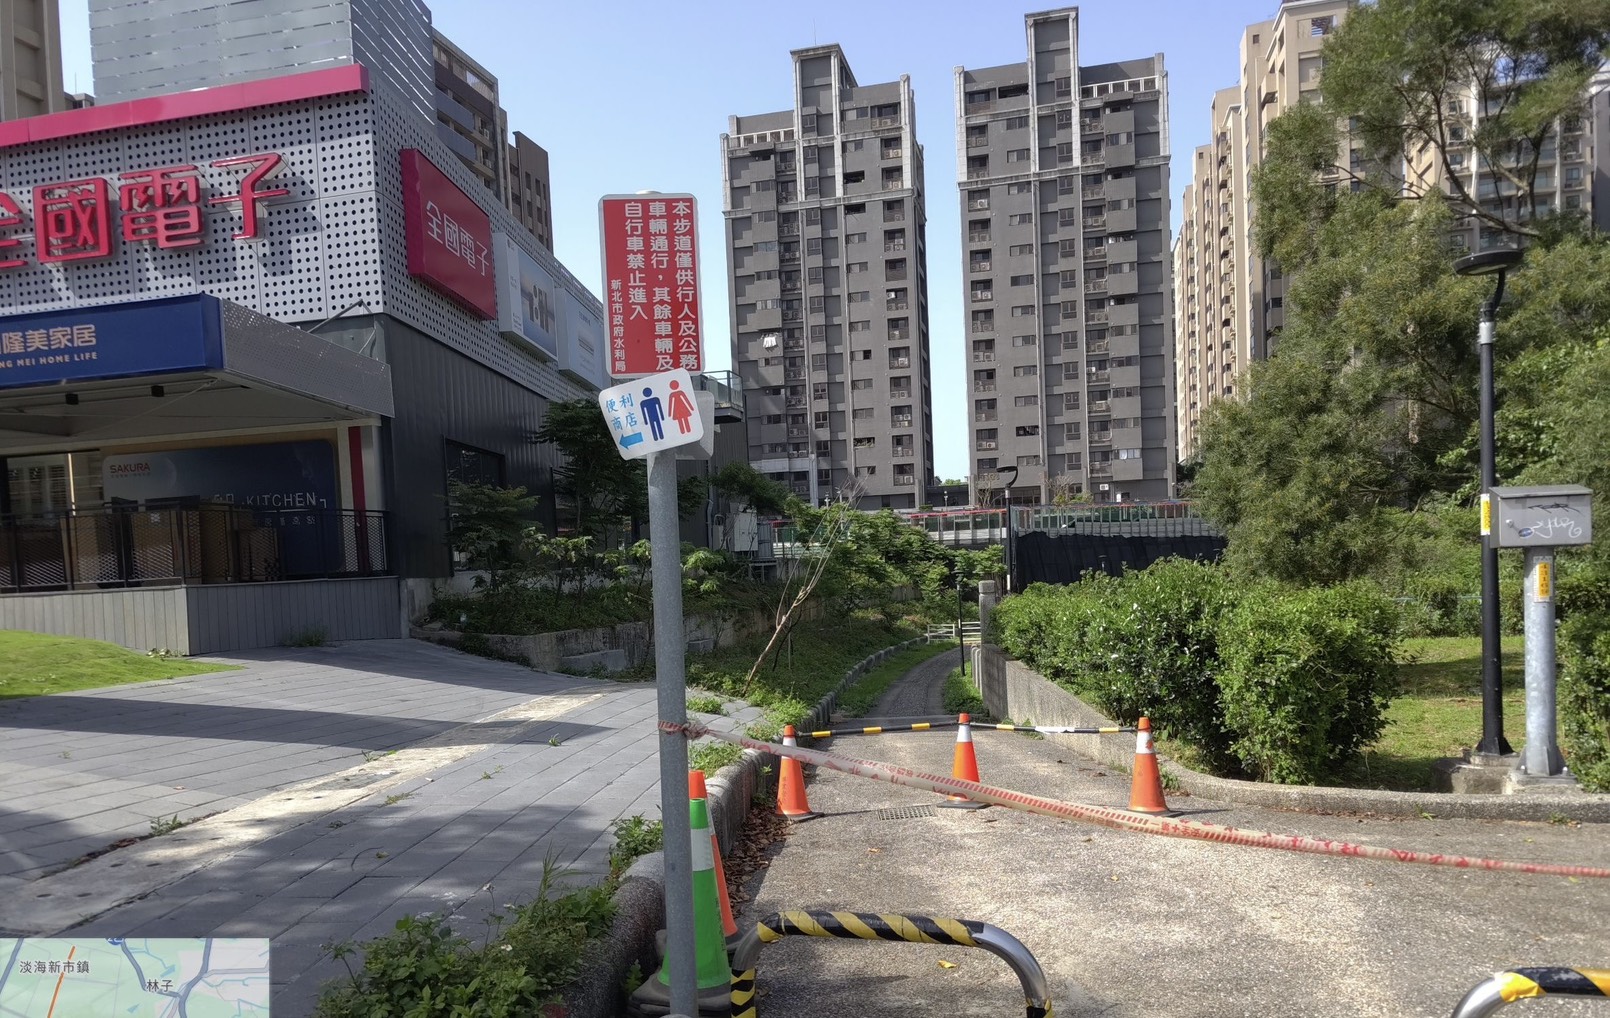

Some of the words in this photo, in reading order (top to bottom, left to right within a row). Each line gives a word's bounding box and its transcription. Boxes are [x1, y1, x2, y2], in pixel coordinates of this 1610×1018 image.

[426, 200, 490, 277] 全國電子
[624, 202, 648, 320] 自行車禁止進入
[672, 201, 698, 371] 本步道僅供行人及公務
[610, 279, 627, 372] 新北市政府水利局
[39, 354, 70, 365] HOME
[74, 352, 98, 361] LIFE
[605, 392, 634, 414] 便利
[611, 411, 639, 431] 商店
[109, 462, 151, 474] SAKURA
[246, 491, 317, 507] KITCHEN
